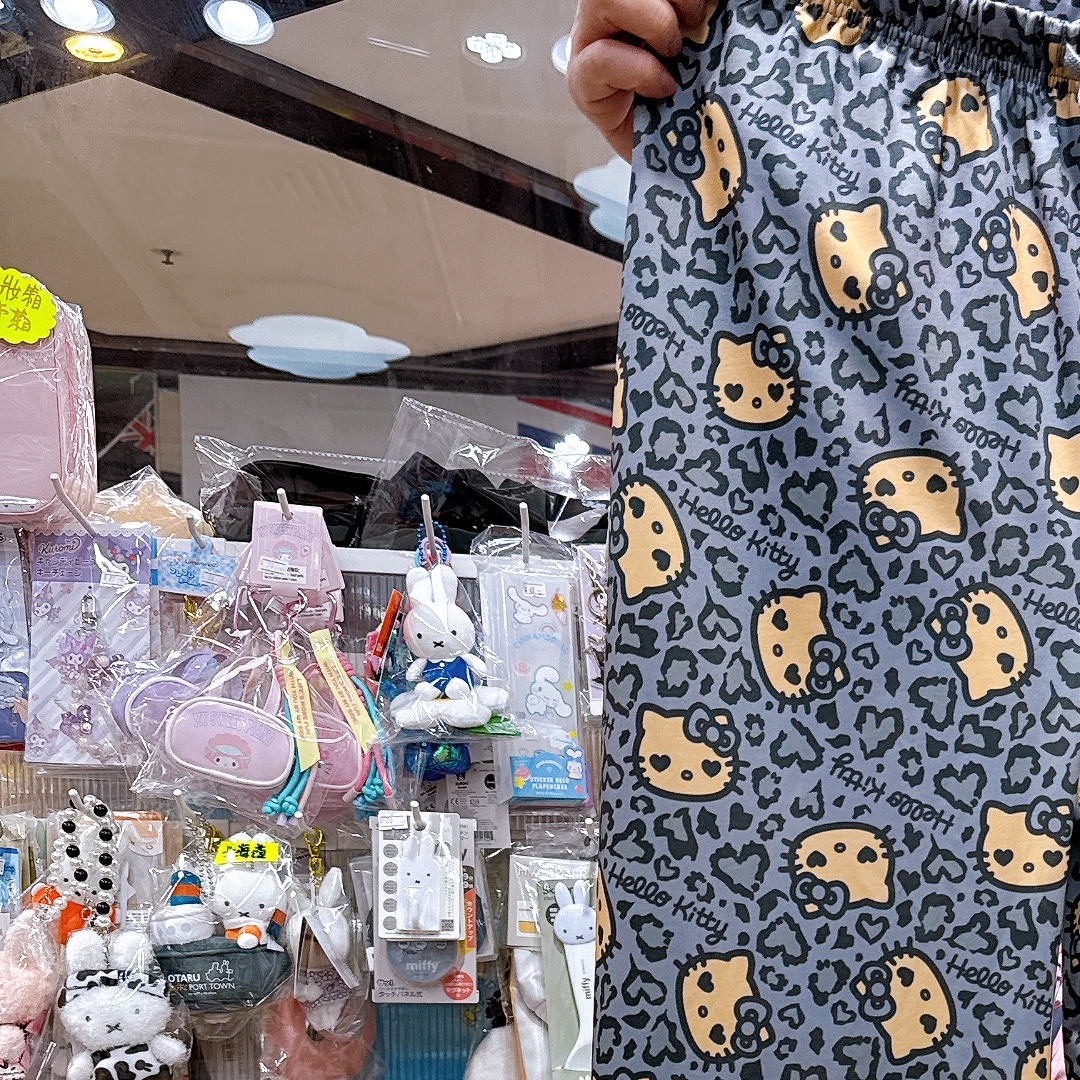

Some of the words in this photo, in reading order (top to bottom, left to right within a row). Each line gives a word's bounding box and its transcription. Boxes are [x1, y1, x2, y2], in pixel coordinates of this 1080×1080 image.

[739, 101, 803, 149] Hello
[805, 140, 861, 195] Kitty
[624, 303, 686, 359] Hello
[893, 373, 954, 427] Kitty
[953, 414, 1022, 462] Hello
[38, 537, 82, 556] Kuromi
[677, 488, 746, 541] Hello
[746, 531, 800, 580] Kitty
[192, 711, 209, 728] MY
[831, 752, 888, 804] Kitty
[886, 791, 956, 834] Hello
[607, 865, 673, 906] Hello
[672, 894, 730, 944] Kitty
[167, 972, 201, 984] OTARU
[189, 982, 209, 991] PORT
[210, 982, 236, 991] TOWN
[406, 960, 441, 973] miffy
[945, 956, 1013, 997] Hello
[581, 977, 592, 1000] miffy
